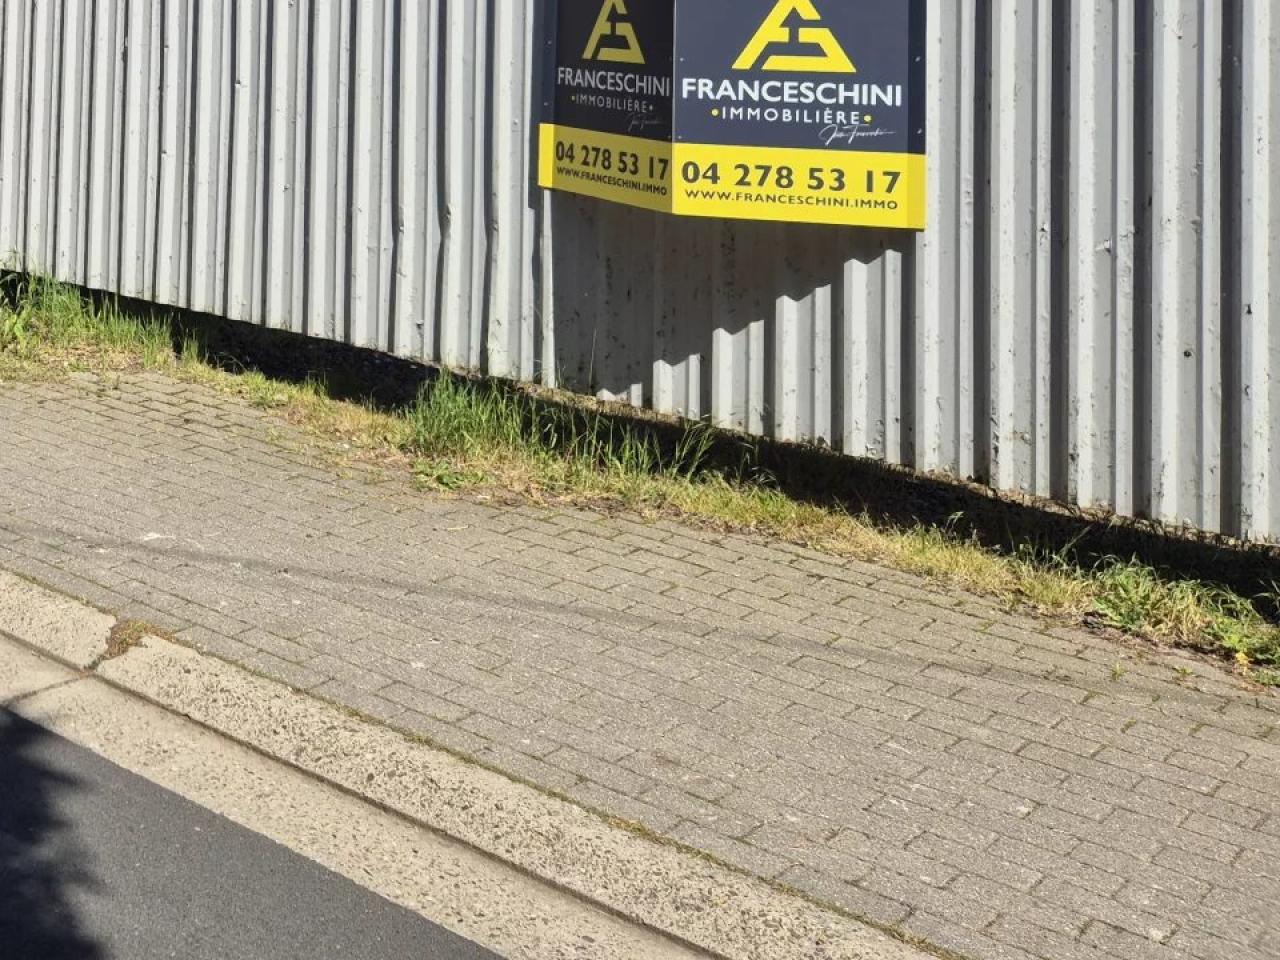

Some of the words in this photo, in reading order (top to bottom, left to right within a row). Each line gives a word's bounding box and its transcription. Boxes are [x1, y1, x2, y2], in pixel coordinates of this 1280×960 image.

[557, 67, 670, 97] FRANCESCHINI
[682, 78, 902, 107] FRANCESCHINI
[722, 106, 860, 125] IMMOBILIÈRE
[555, 141, 575, 163] 04
[581, 145, 612, 170] 278
[618, 152, 639, 175] 53
[648, 156, 669, 180] 17
[557, 166, 667, 196] WWW.FRANCESCHINI.IMMO
[682, 161, 720, 185] 04
[734, 164, 794, 189] 278
[807, 167, 845, 191] 53
[866, 170, 901, 194] 17
[685, 189, 898, 210] WWW.FRANCESCHINI.IMMO
